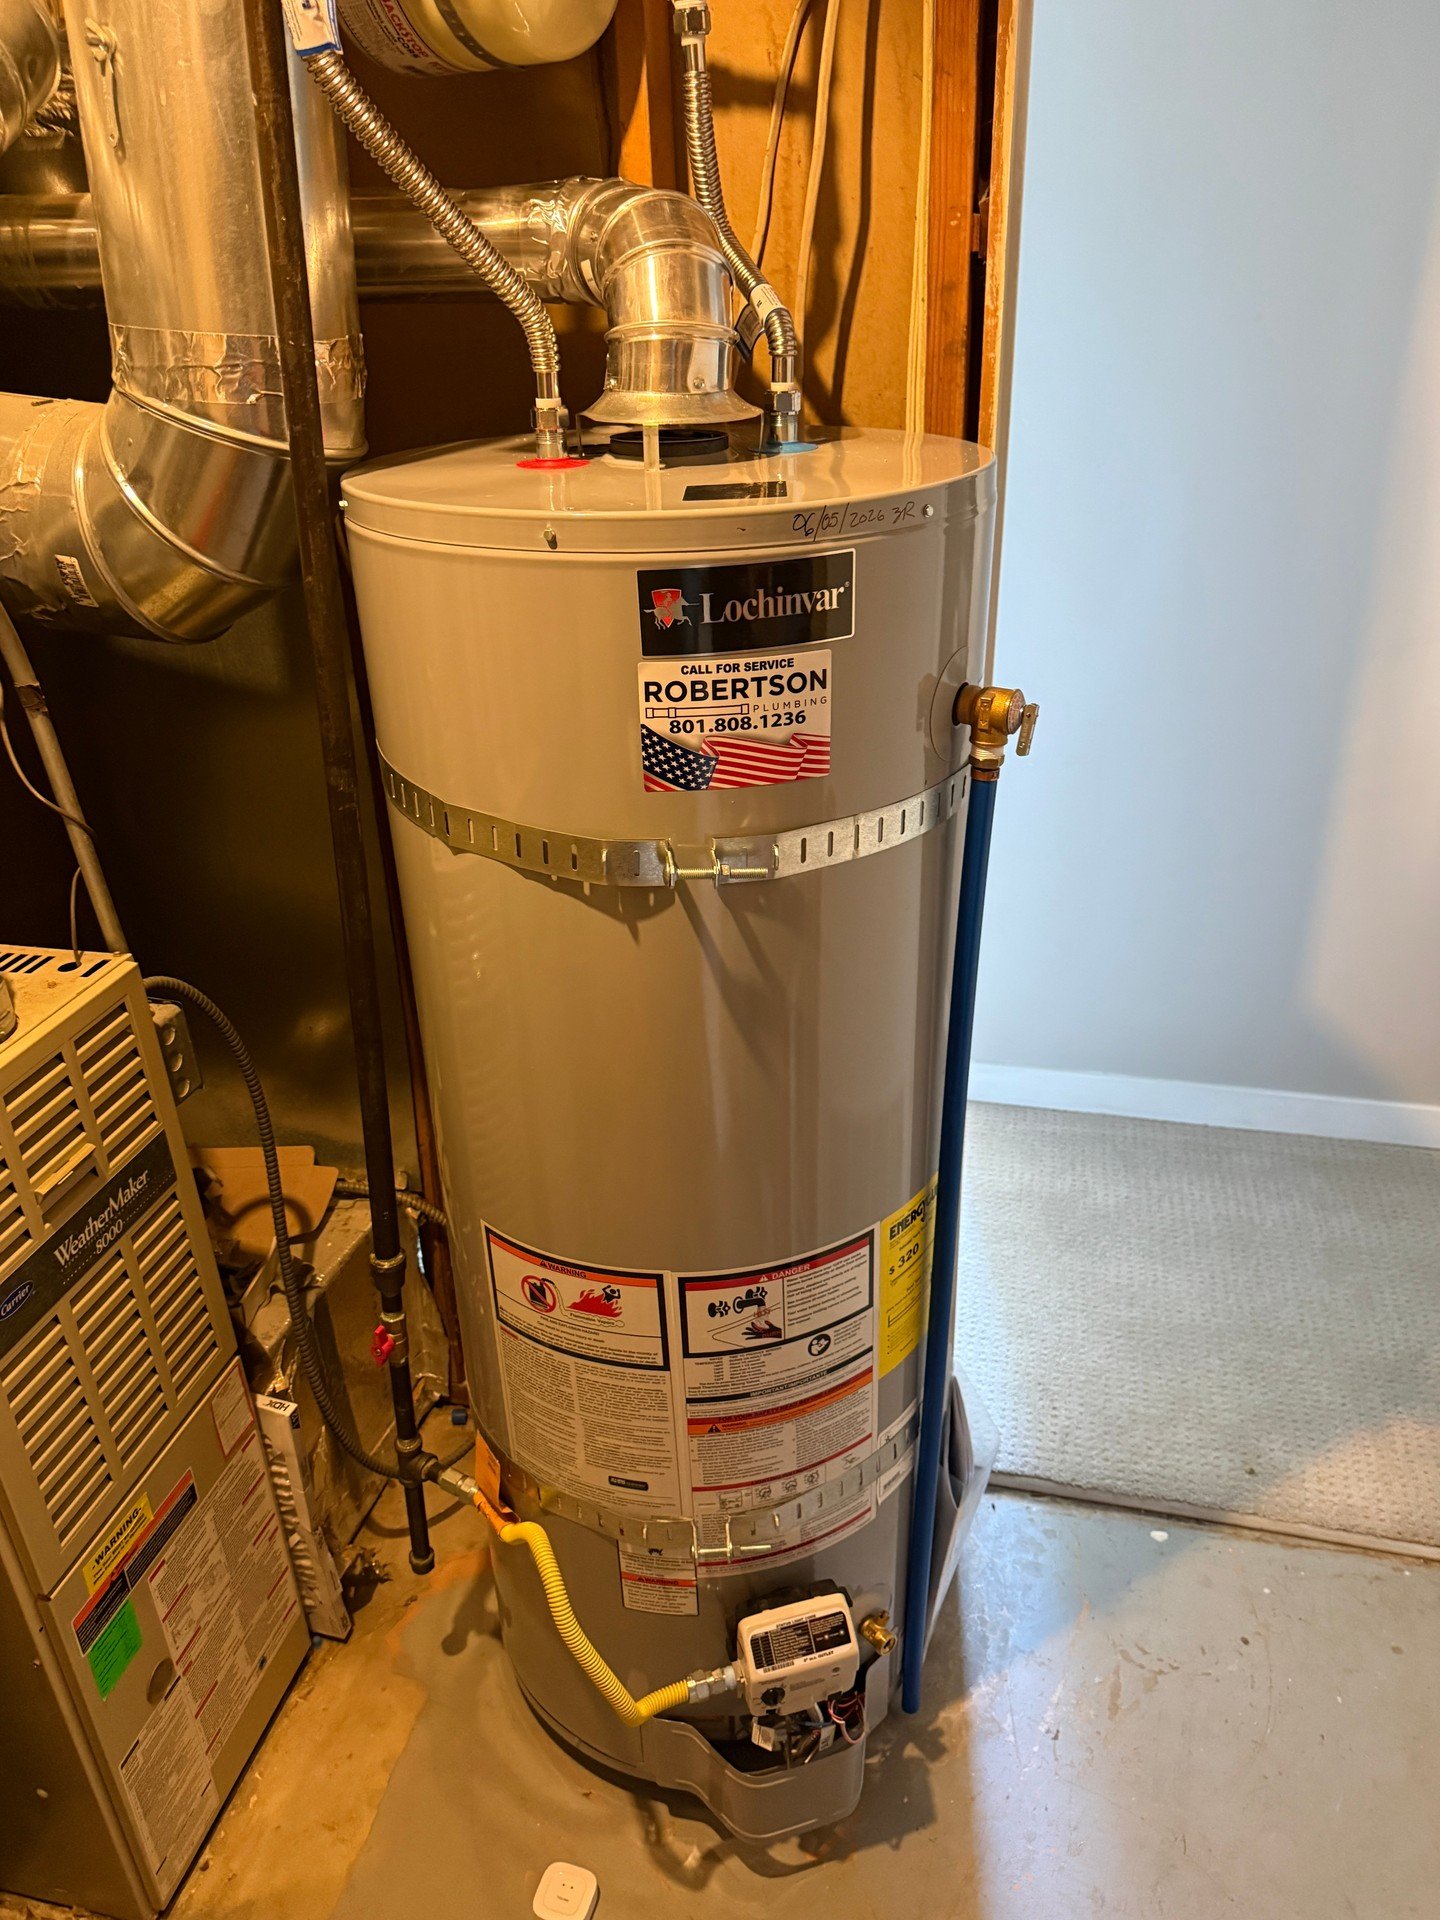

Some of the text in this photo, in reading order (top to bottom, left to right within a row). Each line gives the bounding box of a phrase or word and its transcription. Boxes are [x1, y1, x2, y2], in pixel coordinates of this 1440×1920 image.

[699, 585, 845, 624] Lochinvar
[681, 658, 795, 675] CALL FOR SERVICE
[644, 669, 827, 702] ROBERTSON
[753, 696, 827, 713] PLUMBING
[669, 710, 806, 733] 801.808.1236
[53, 1170, 148, 1267] WeatherMaker
[96, 1219, 123, 1254] 8000
[898, 1242, 919, 1268] 320
[547, 1262, 587, 1279] WARNING
[772, 1263, 811, 1281] DANGER
[0, 1284, 30, 1317] Carrier
[266, 1400, 290, 1412] HDX
